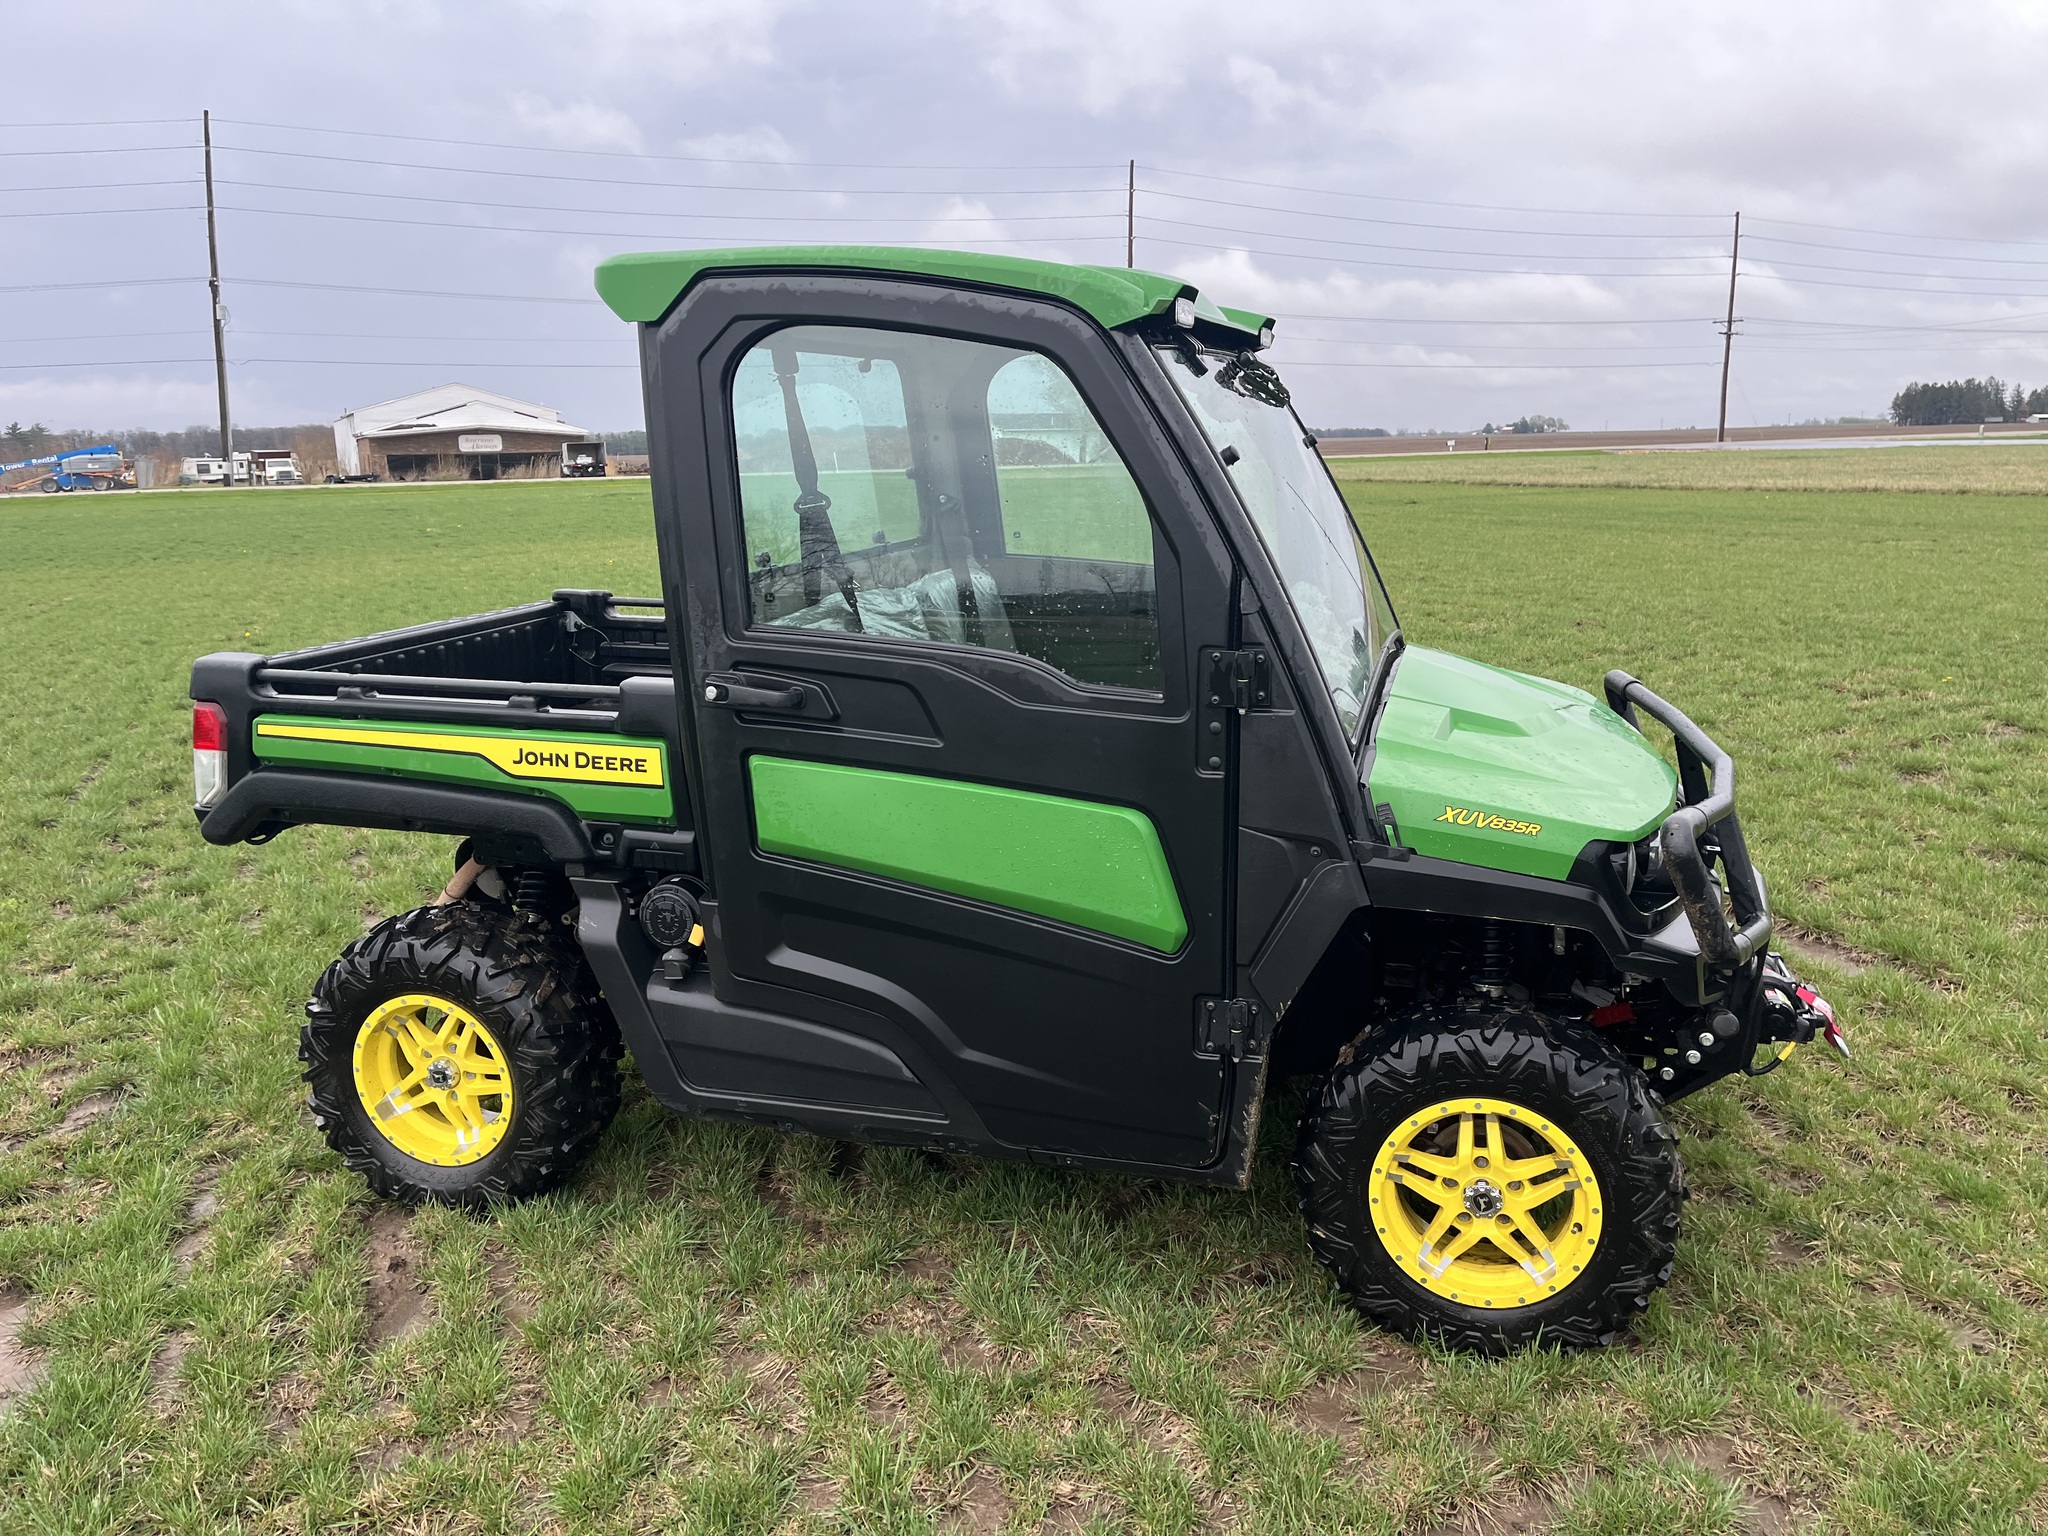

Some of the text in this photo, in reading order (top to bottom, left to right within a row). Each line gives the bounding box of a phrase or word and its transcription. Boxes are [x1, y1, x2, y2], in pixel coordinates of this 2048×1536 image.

[31, 454, 58, 466] Rental
[513, 748, 648, 773] JOHN DEERE
[1434, 805, 1543, 836] XUV835R
